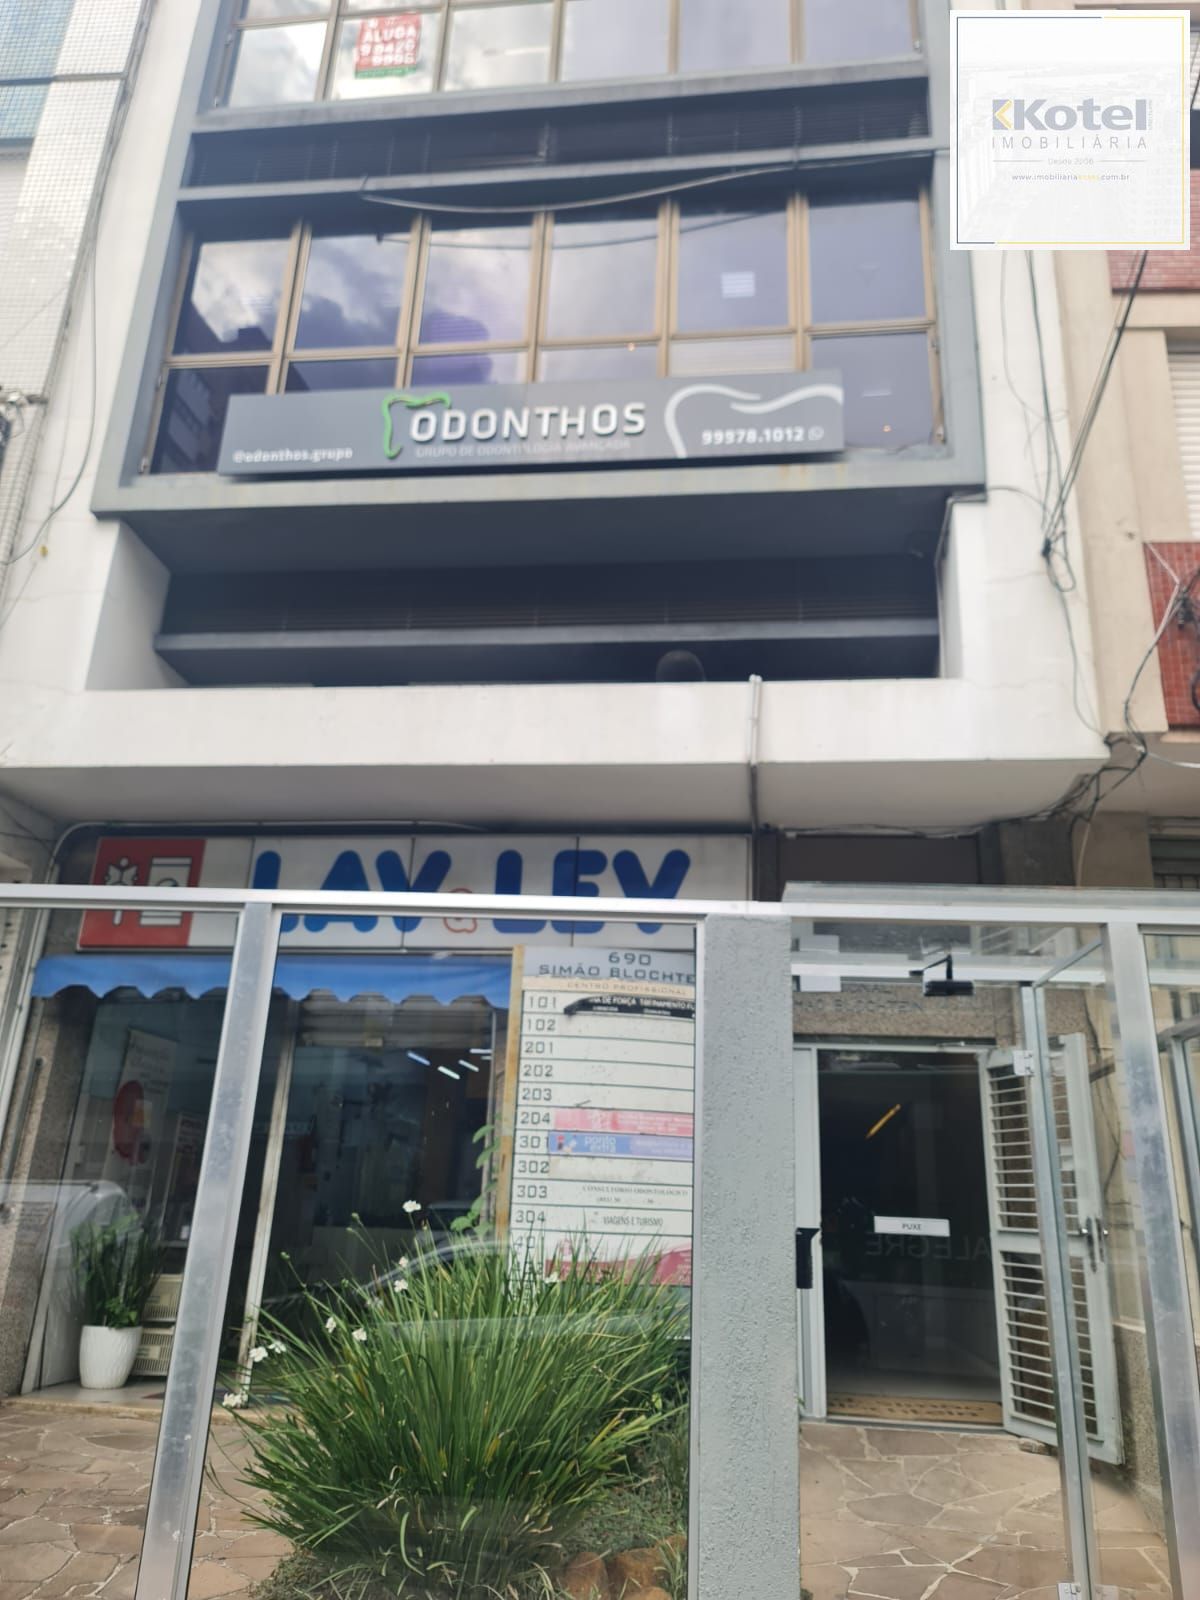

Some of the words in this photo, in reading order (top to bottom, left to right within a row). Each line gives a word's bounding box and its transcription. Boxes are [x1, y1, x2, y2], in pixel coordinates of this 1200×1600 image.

[362, 26, 417, 43] ALUGA
[409, 402, 646, 442] ODONTHOS
[702, 428, 804, 445] 99978.1012
[233, 447, 353, 463] @odonthos.grupo
[416, 447, 457, 458] GRUPO
[459, 446, 475, 457] DE
[608, 952, 651, 966] 690
[539, 963, 600, 977] SIMÃO
[567, 982, 609, 990] CENTRO
[613, 984, 687, 996] PROFISSIONAL
[529, 996, 557, 1009] 101
[527, 1019, 556, 1031] 102
[525, 1041, 554, 1054] 201
[523, 1065, 554, 1077] 202
[522, 1088, 552, 1101] 203
[520, 1112, 550, 1125] 204
[519, 1136, 549, 1149] 301
[517, 1160, 549, 1174] 302
[517, 1185, 548, 1198] 303
[515, 1210, 546, 1223] 304
[902, 1223, 922, 1231] PUXE
[513, 1236, 544, 1250] 40
